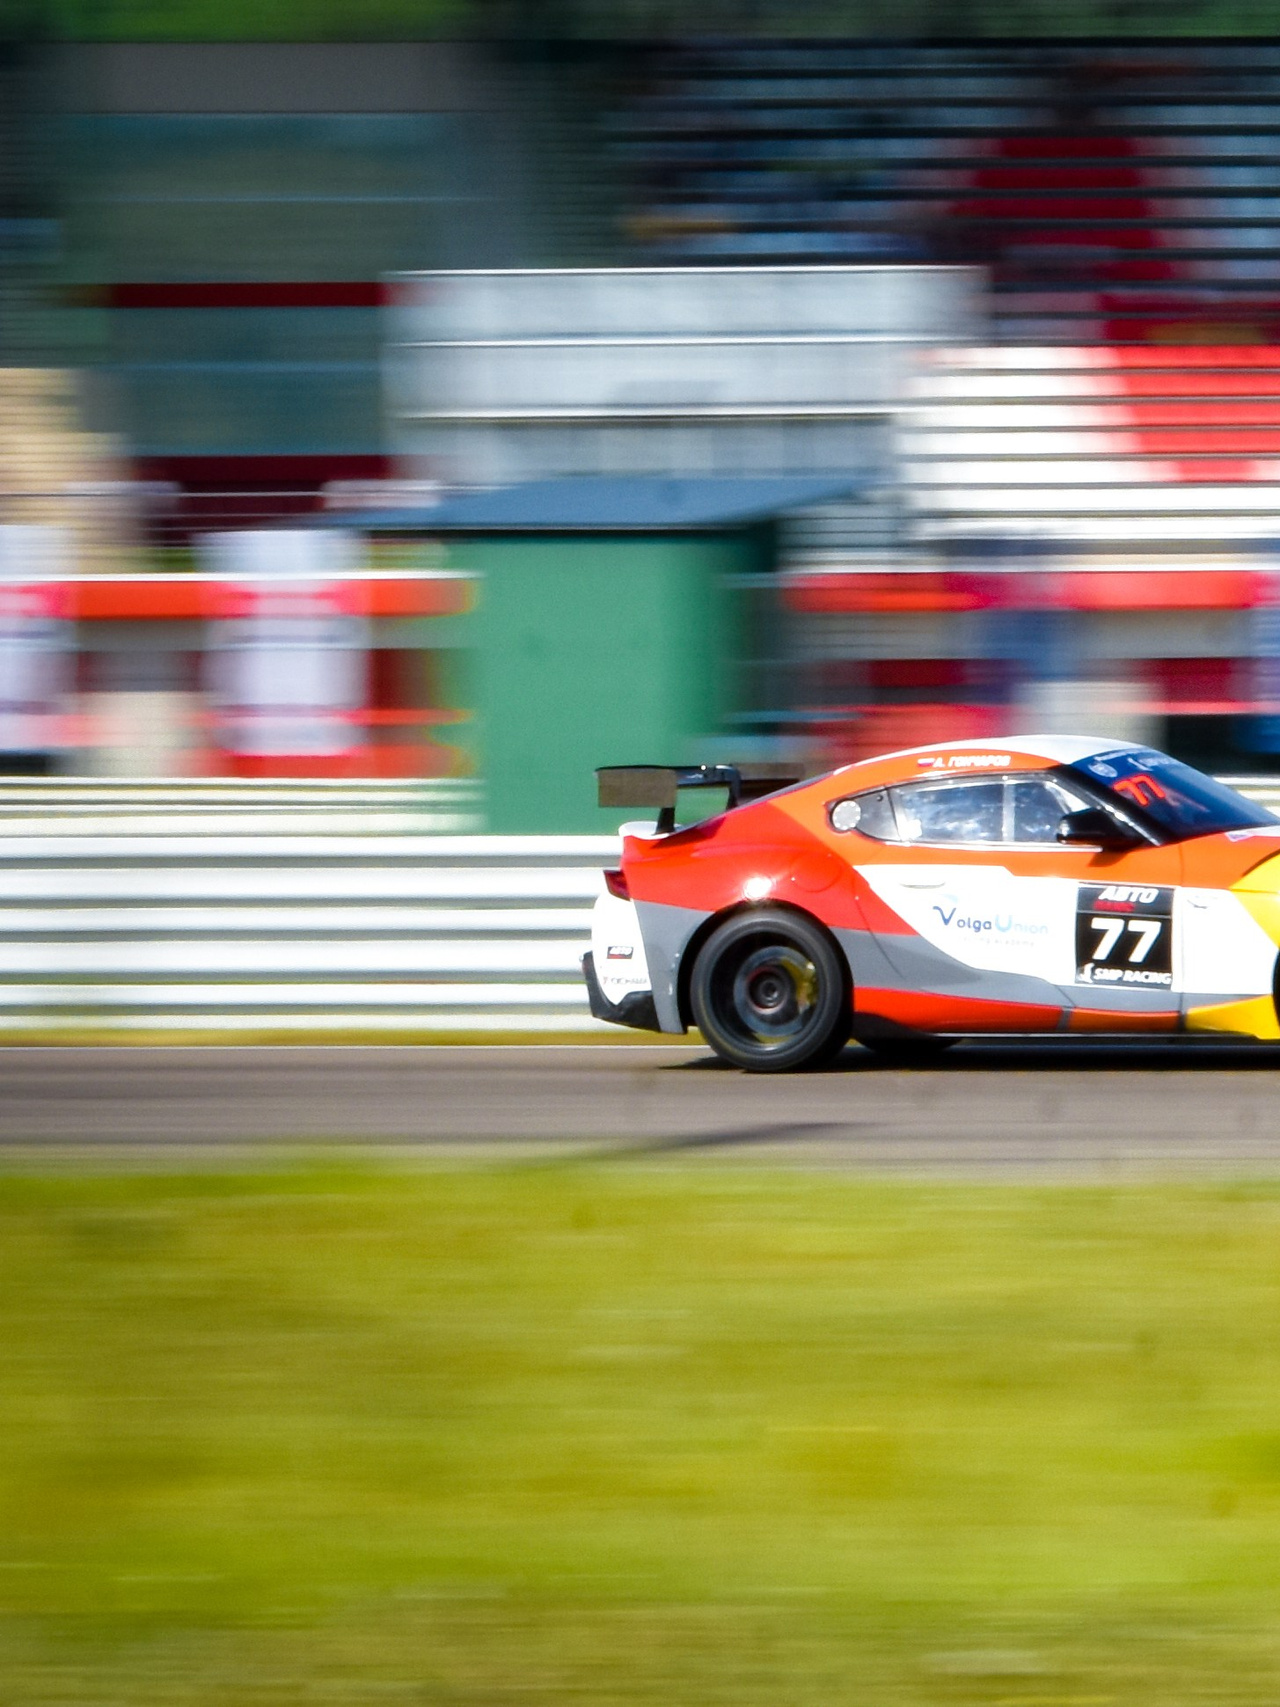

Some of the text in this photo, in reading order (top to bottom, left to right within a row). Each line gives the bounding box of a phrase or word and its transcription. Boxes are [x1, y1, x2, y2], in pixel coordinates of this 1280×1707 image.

[1112, 773, 1166, 807] 77
[932, 905, 1049, 935] Volga Union
[1090, 917, 1162, 963] 77
[1093, 967, 1173, 985] SMP RACING
